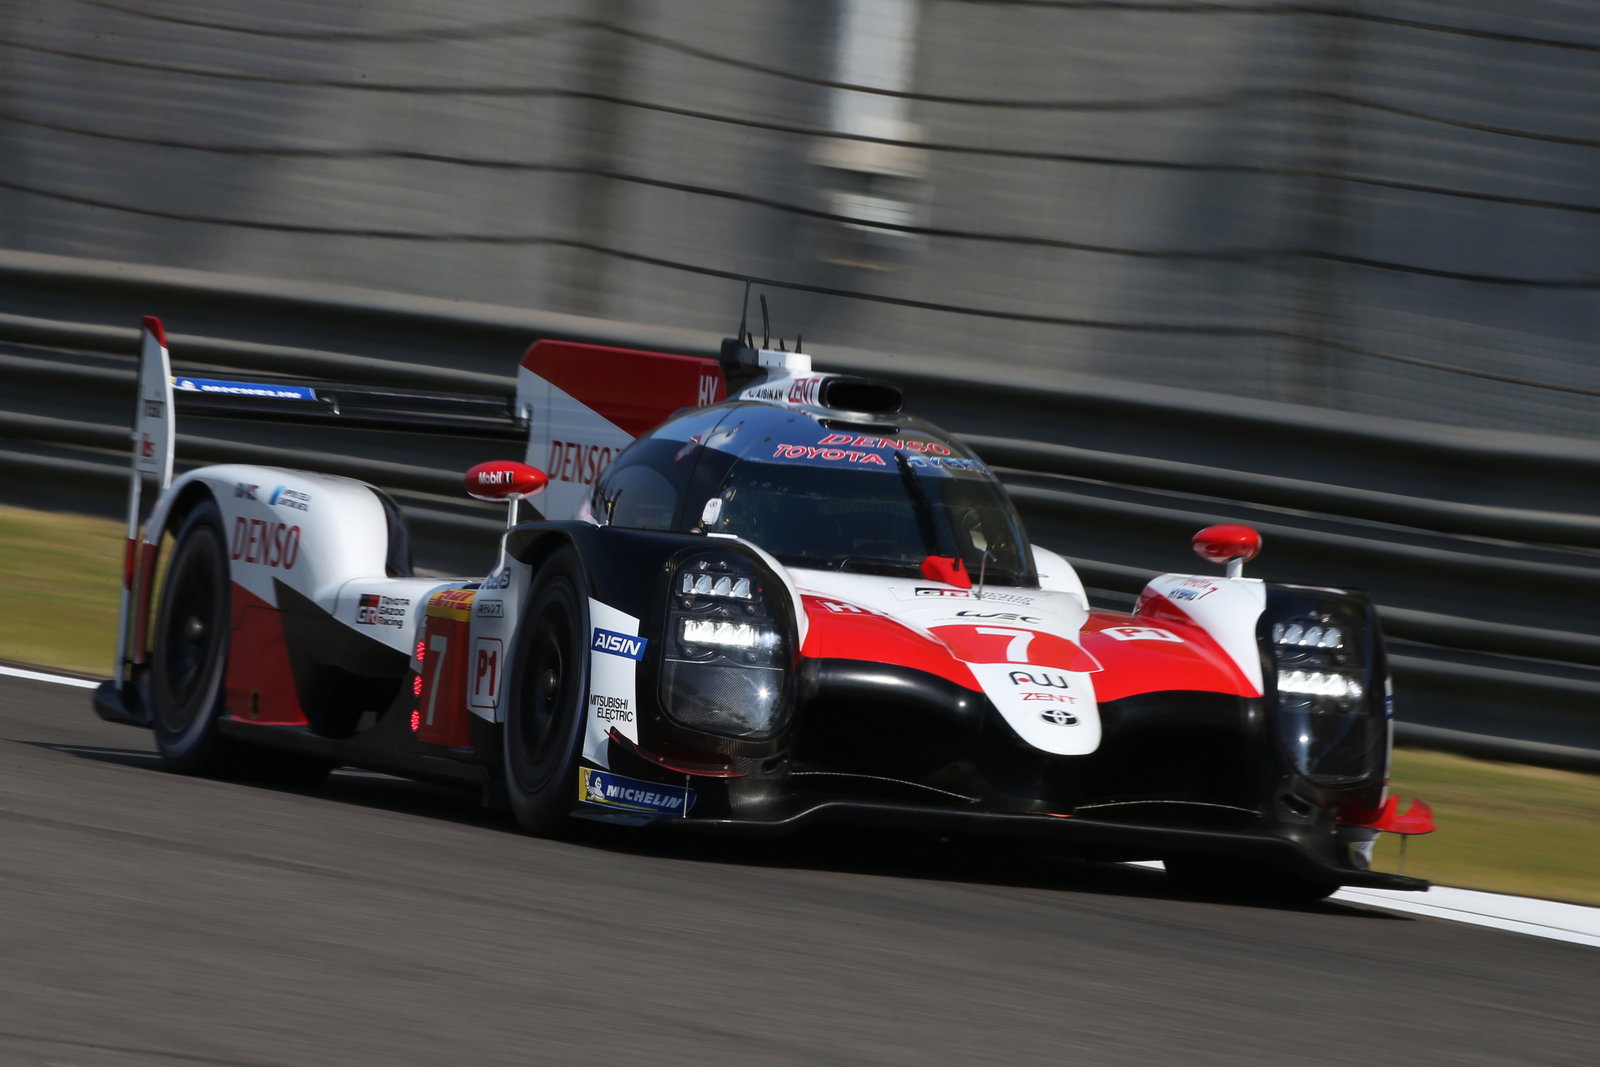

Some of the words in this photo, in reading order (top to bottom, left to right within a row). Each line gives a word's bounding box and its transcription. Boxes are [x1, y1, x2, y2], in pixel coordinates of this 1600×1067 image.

[201, 385, 302, 399] MICHELIN
[788, 378, 821, 405] ZENT
[773, 443, 886, 466] TOYOTA
[817, 433, 951, 456] DENSO
[478, 471, 502, 484] Mobil
[231, 516, 301, 570] DENSO
[594, 633, 642, 656] AISIN
[975, 627, 1036, 663] 7
[426, 634, 448, 726] 7
[475, 649, 497, 697] P1
[589, 694, 629, 711] MITSUBISHI
[1019, 692, 1078, 705] ZENT
[596, 706, 634, 723] ELECTRIC
[606, 784, 683, 809] MICHELIN
